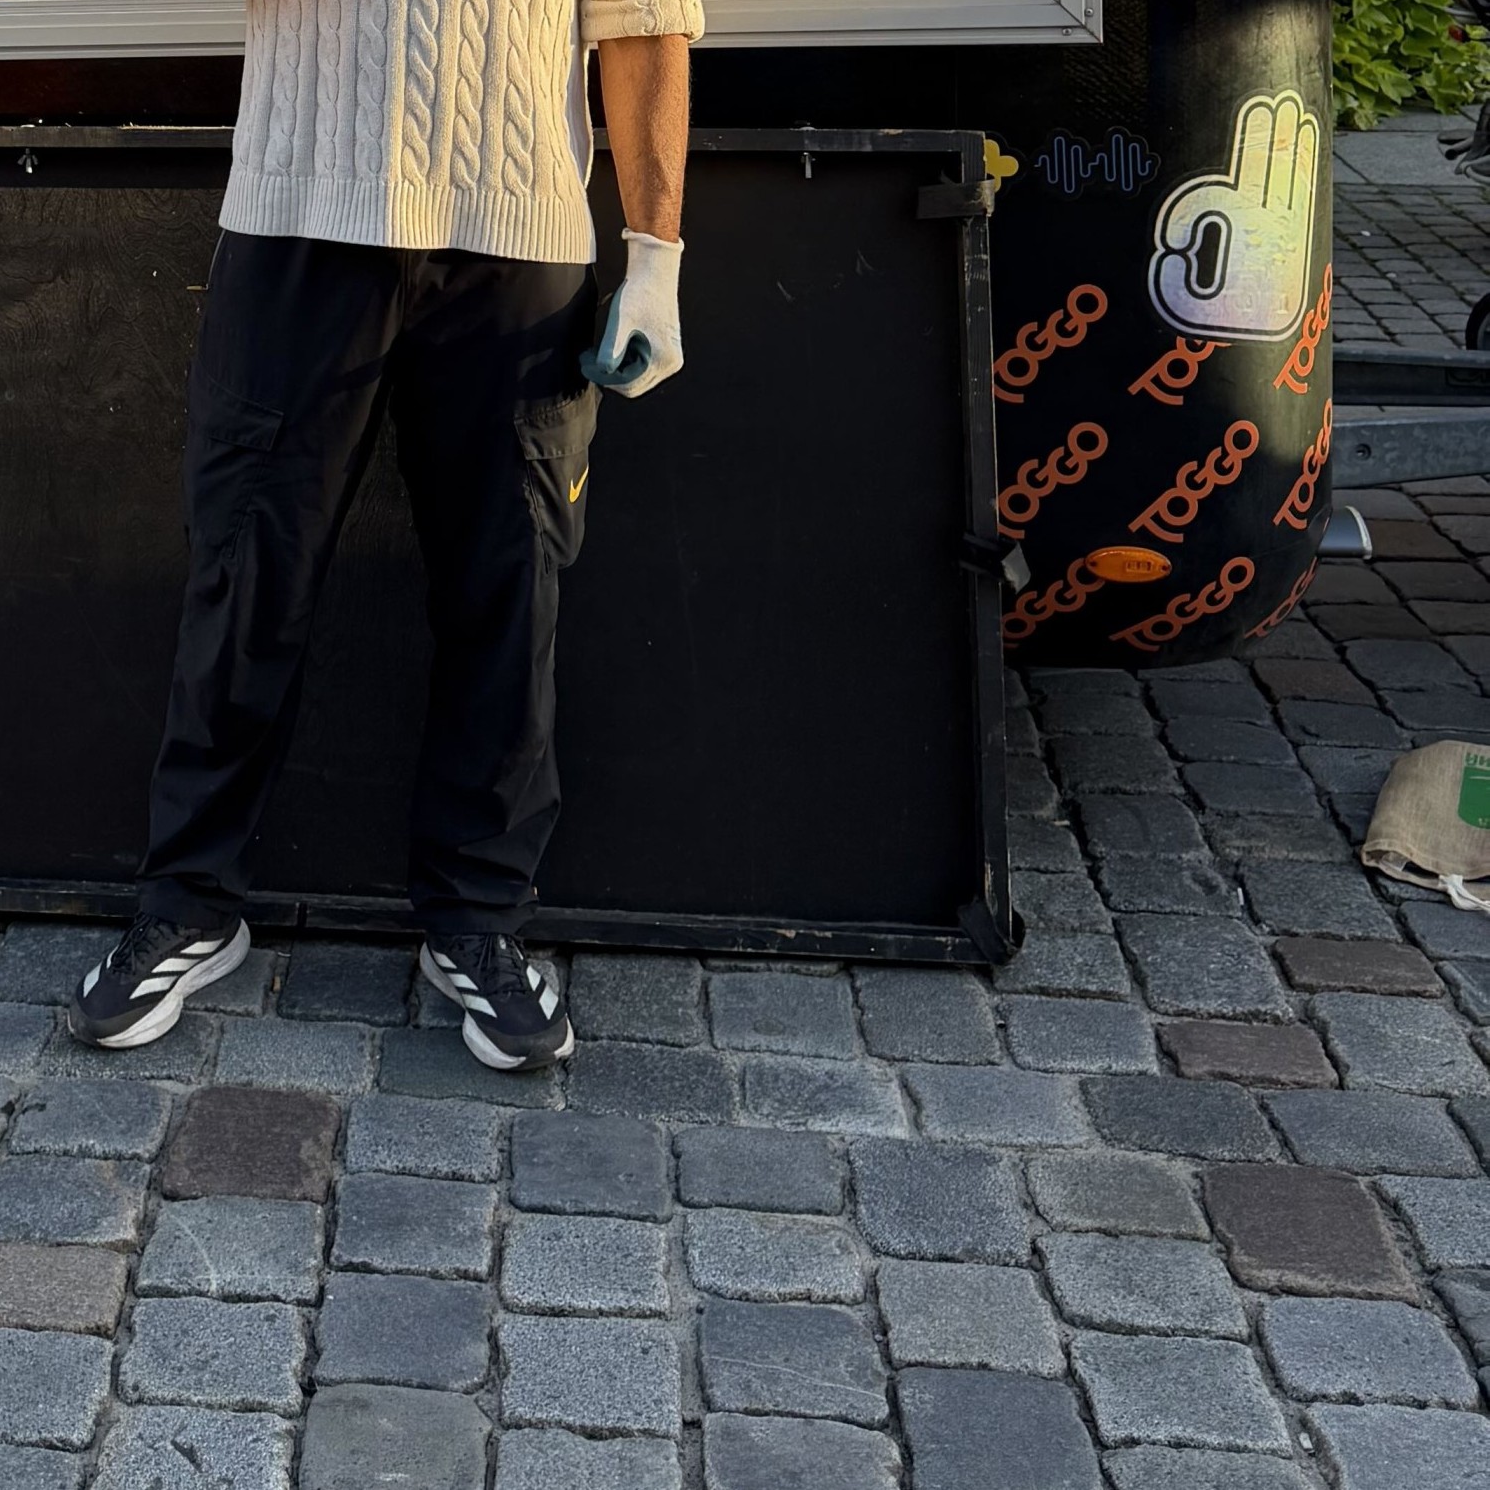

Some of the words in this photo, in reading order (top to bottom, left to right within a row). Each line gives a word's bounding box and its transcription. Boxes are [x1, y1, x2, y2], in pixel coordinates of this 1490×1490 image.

[1273, 263, 1332, 395] TOGGO
[1128, 420, 1260, 543] TOGGO
[1273, 398, 1332, 530] TOGGO
[1110, 556, 1255, 651] TOGGO
